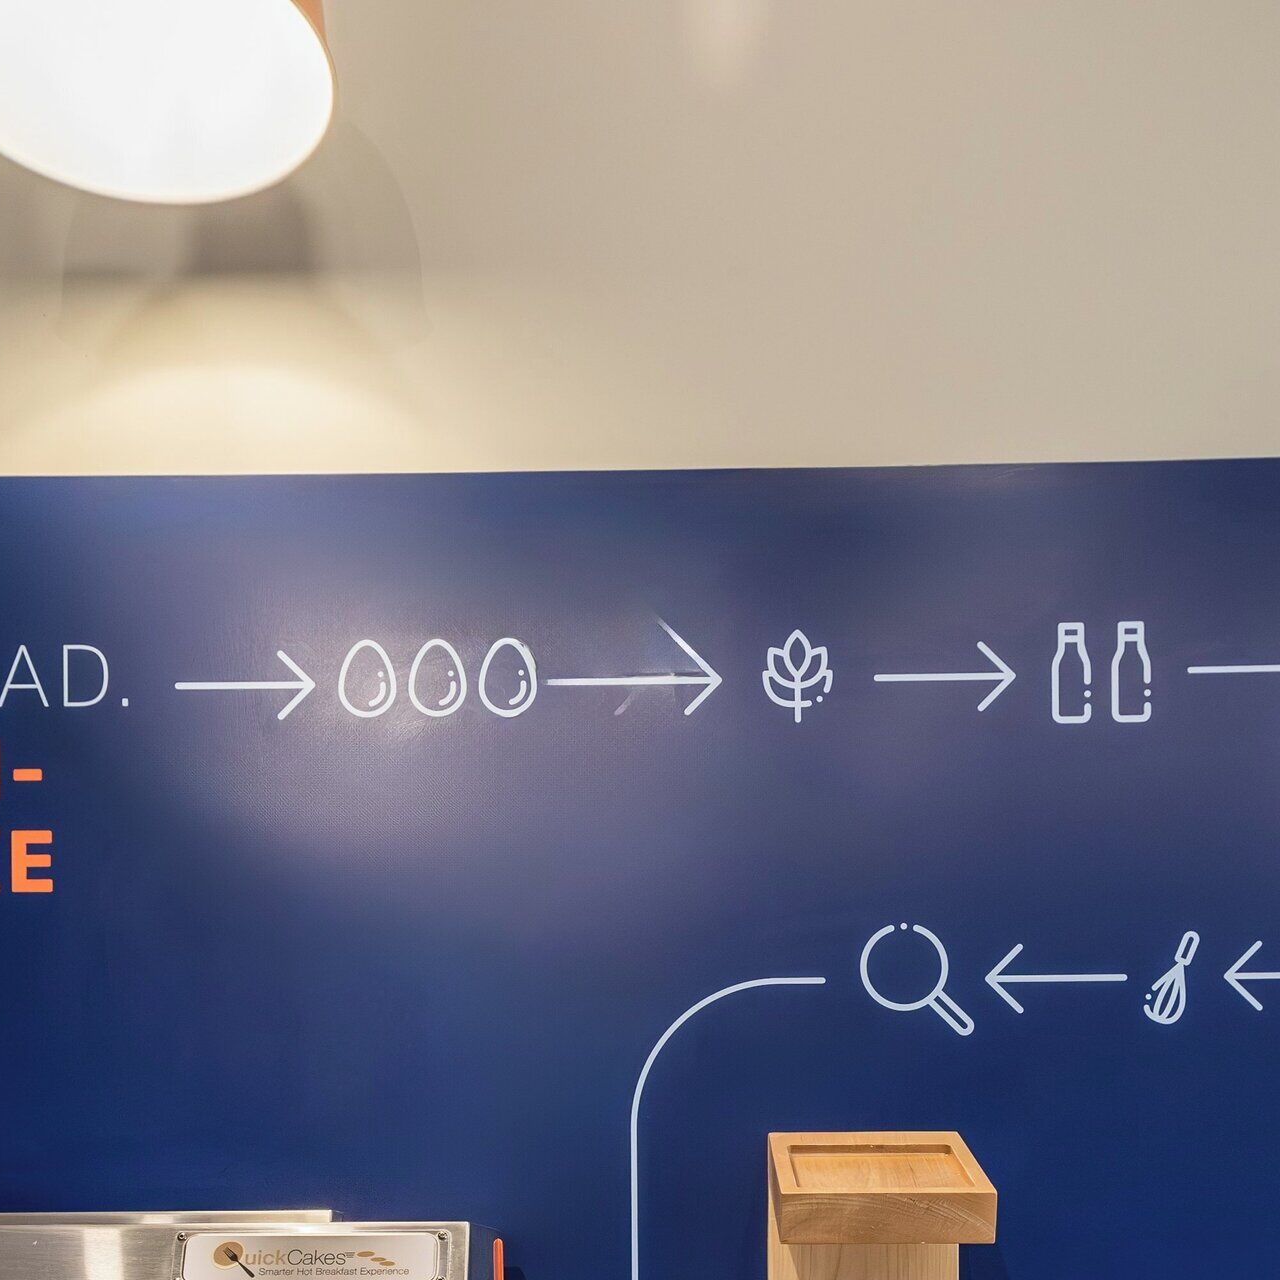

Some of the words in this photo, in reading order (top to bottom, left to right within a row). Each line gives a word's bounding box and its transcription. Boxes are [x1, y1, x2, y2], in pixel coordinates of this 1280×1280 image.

[258, 1267, 294, 1276] Smarter
[297, 1267, 313, 1276] Hot
[315, 1267, 358, 1276] Breakfast
[360, 1267, 410, 1277] Experience
